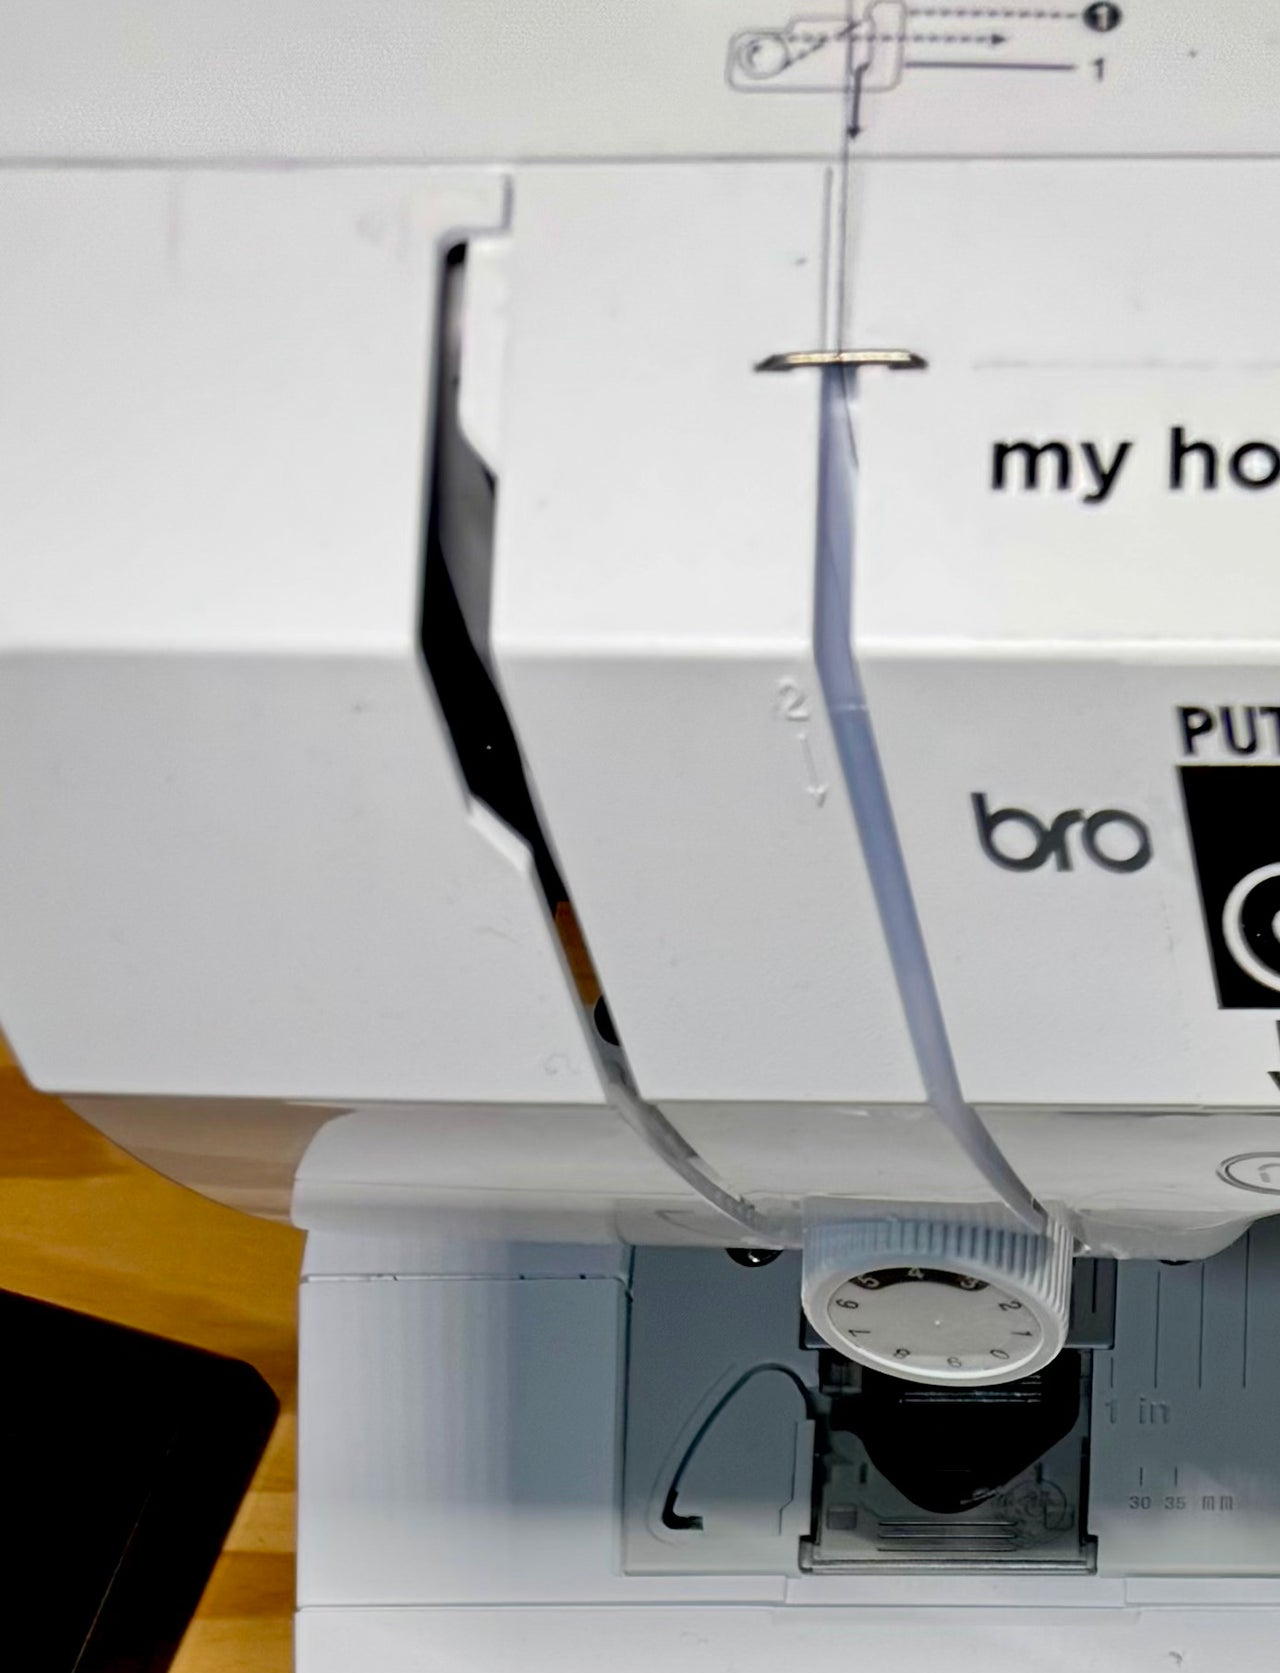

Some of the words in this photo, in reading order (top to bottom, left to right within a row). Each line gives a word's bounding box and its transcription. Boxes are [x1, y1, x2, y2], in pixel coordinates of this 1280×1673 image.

[1092, 57, 1104, 81] 1
[989, 438, 1132, 506] my
[970, 791, 1153, 874] bro
[857, 1274, 880, 1289] 5
[907, 1267, 924, 1280] 4
[998, 1299, 1023, 1313] 2
[1104, 1398, 1118, 1424] 1
[1138, 1397, 1171, 1425] in
[1128, 1495, 1152, 1511] 30
[1164, 1495, 1187, 1511] 35
